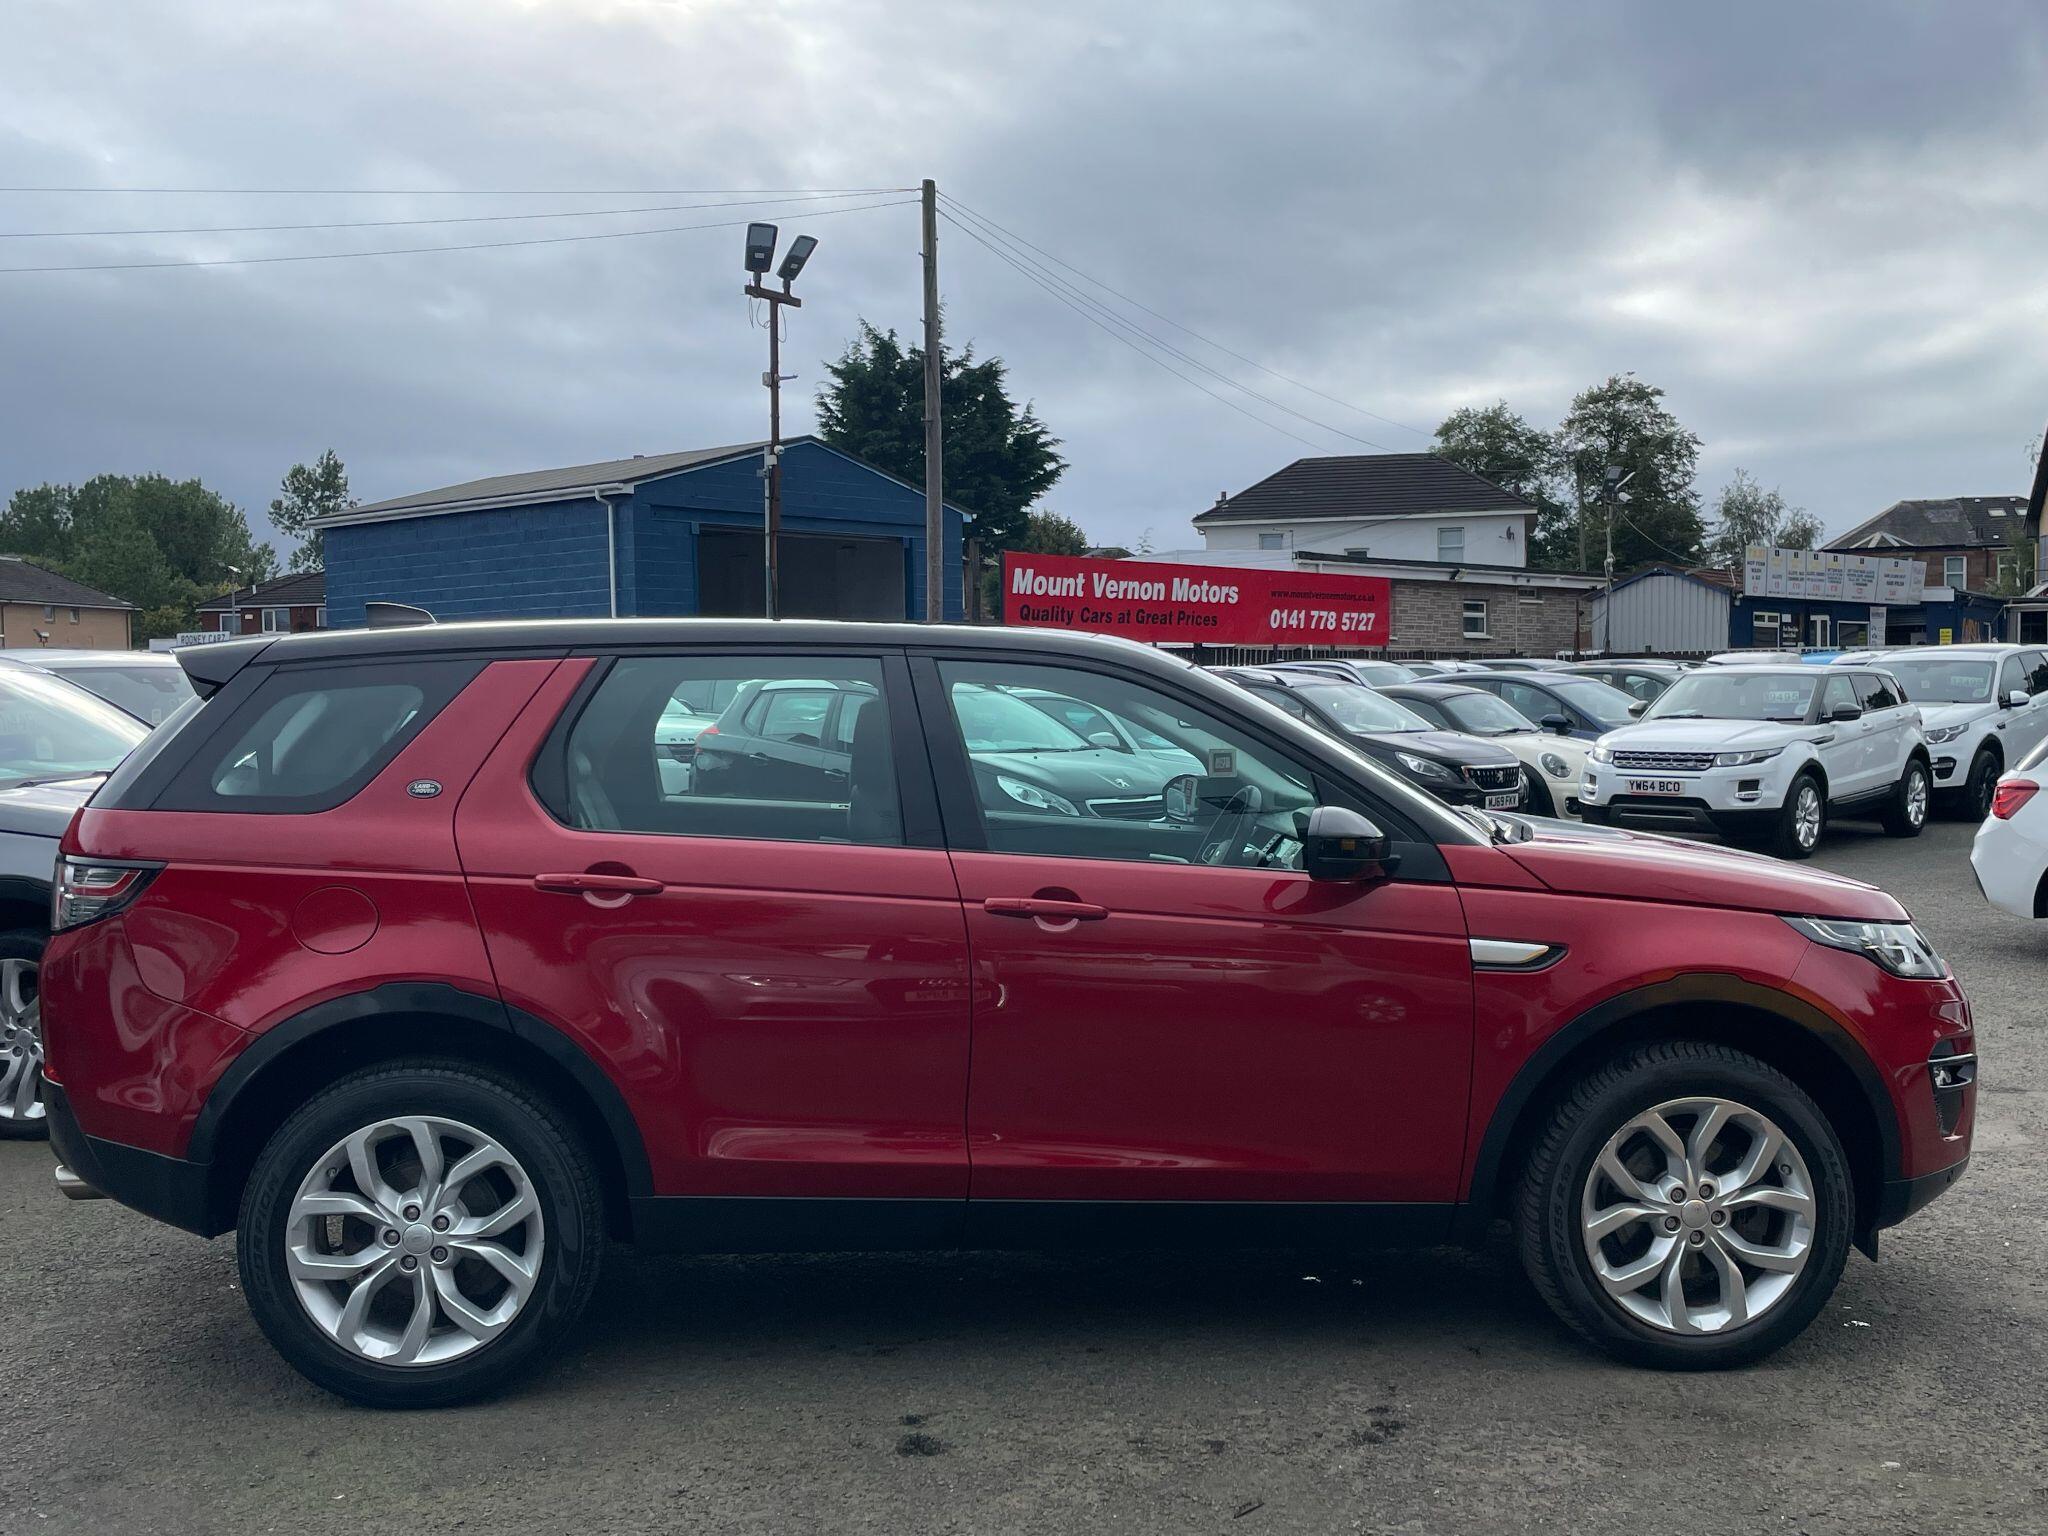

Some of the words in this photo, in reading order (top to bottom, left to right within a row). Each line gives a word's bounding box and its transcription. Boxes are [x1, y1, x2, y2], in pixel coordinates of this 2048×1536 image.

[1012, 567, 1086, 597] Mount
[1092, 572, 1166, 601] Vernon
[1171, 577, 1239, 604] Motors
[1020, 604, 1074, 625] Quality
[1080, 607, 1113, 624] Cars
[1118, 609, 1132, 624] at
[1135, 608, 1173, 625] Great
[1177, 610, 1218, 627] Prices
[1270, 608, 1306, 629] 0141
[1310, 610, 1337, 630] 778
[1341, 612, 1376, 631] 5727
[1629, 780, 1656, 791] YW64
